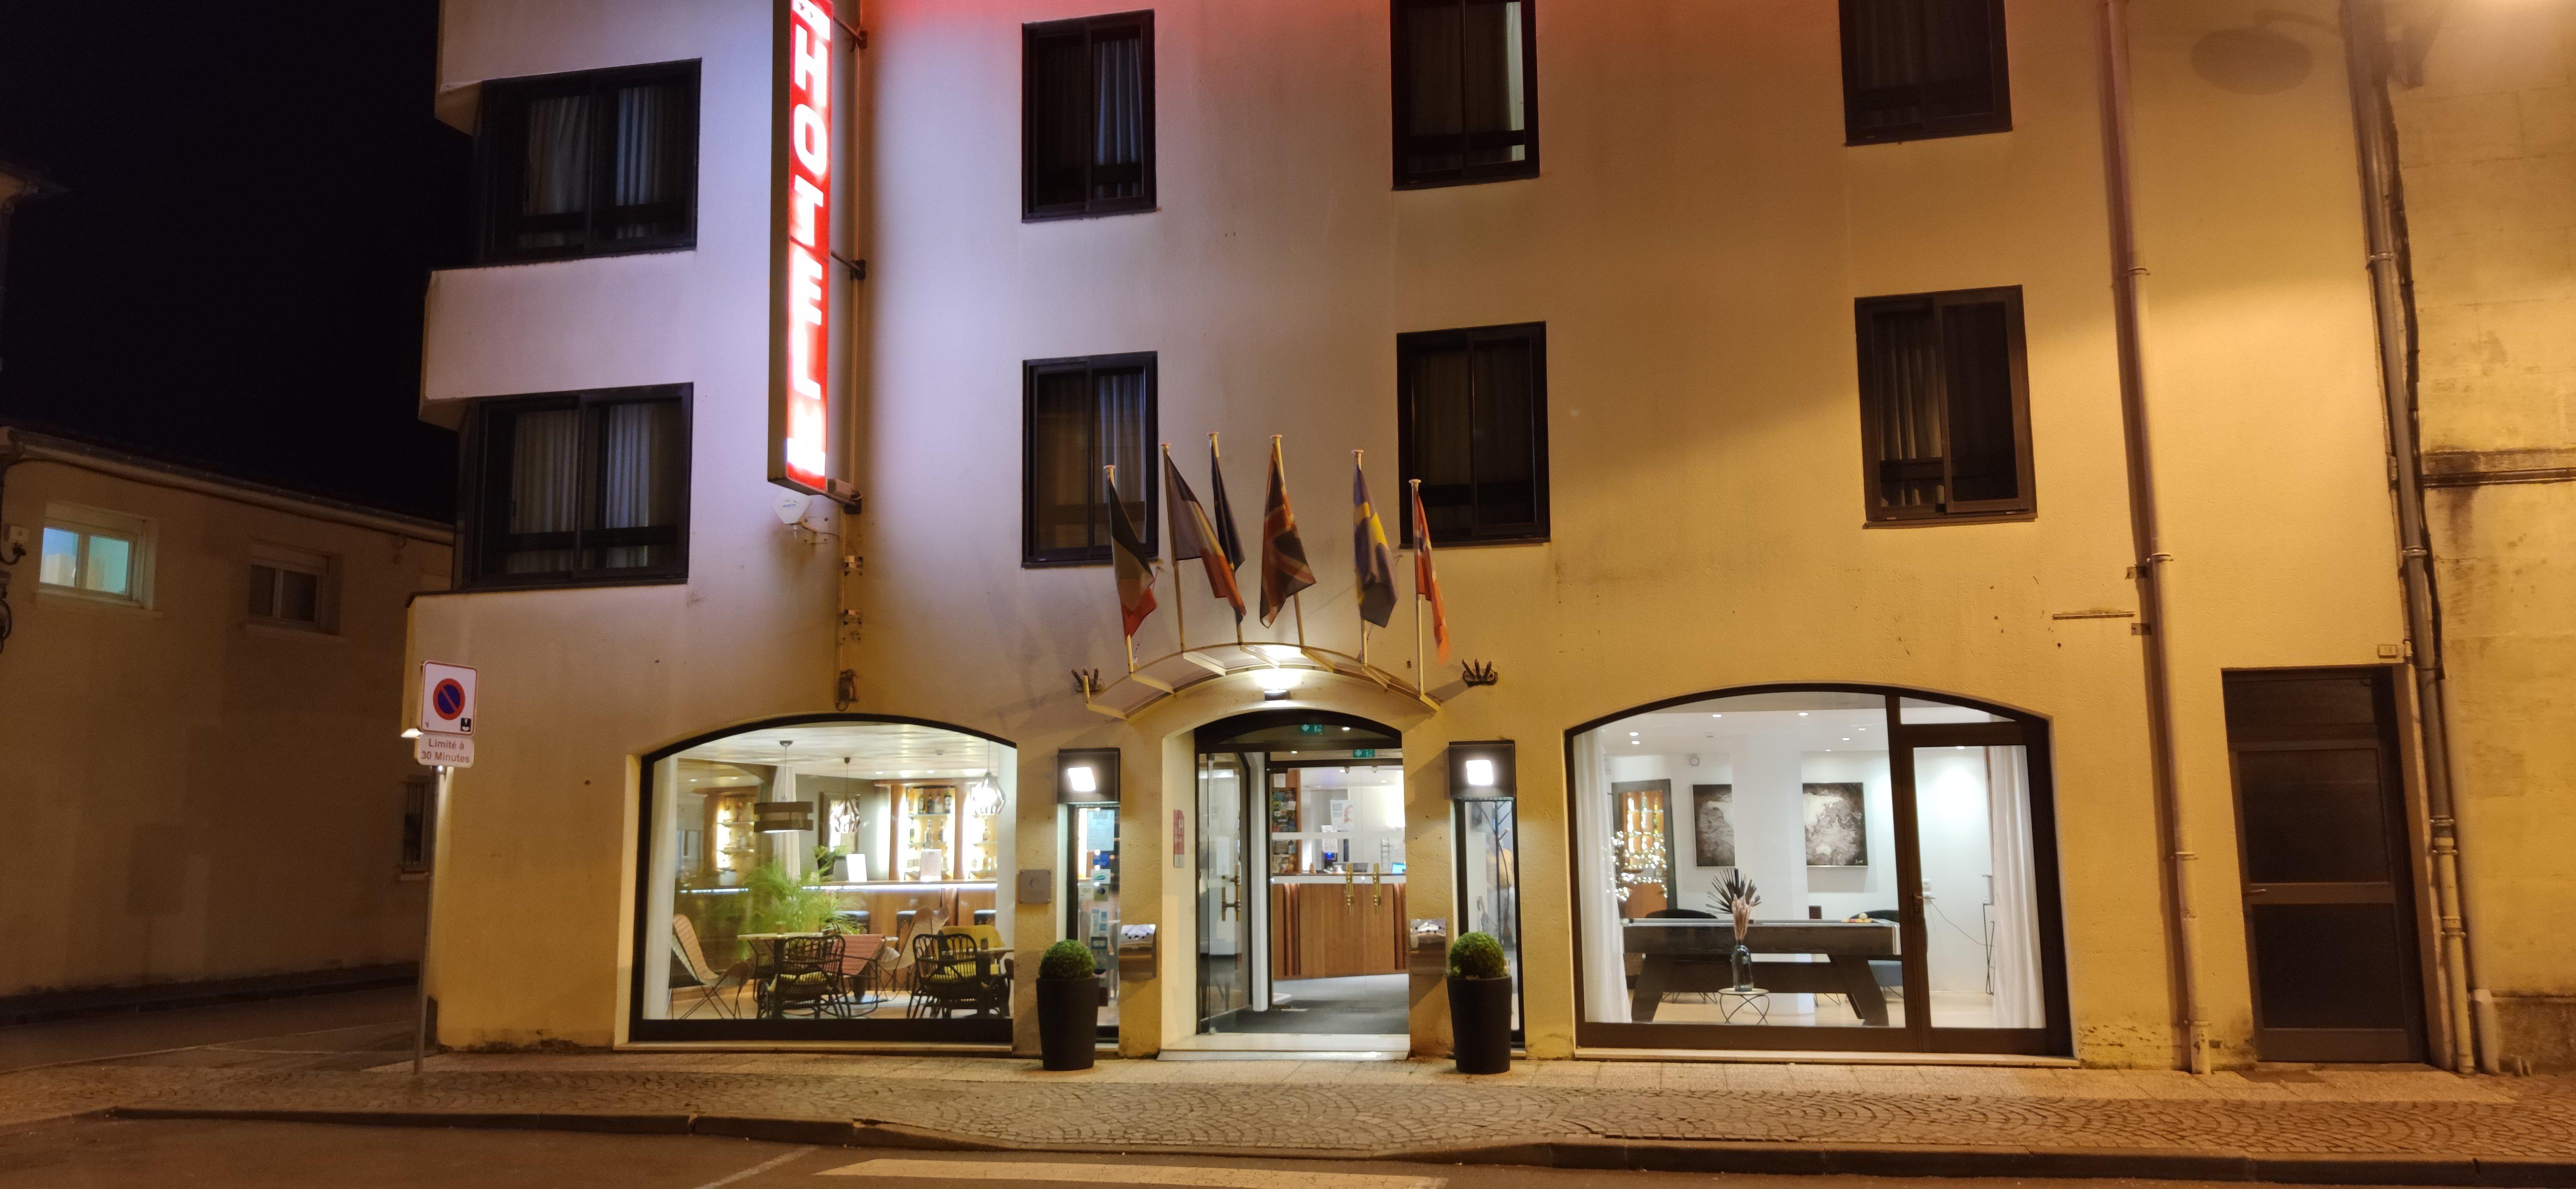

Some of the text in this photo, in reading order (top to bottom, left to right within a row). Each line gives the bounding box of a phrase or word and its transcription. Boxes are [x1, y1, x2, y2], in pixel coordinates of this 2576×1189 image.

[793, 24, 827, 400] HOTEL
[429, 738, 456, 749] Limité
[421, 750, 470, 763] 30 Minutes
